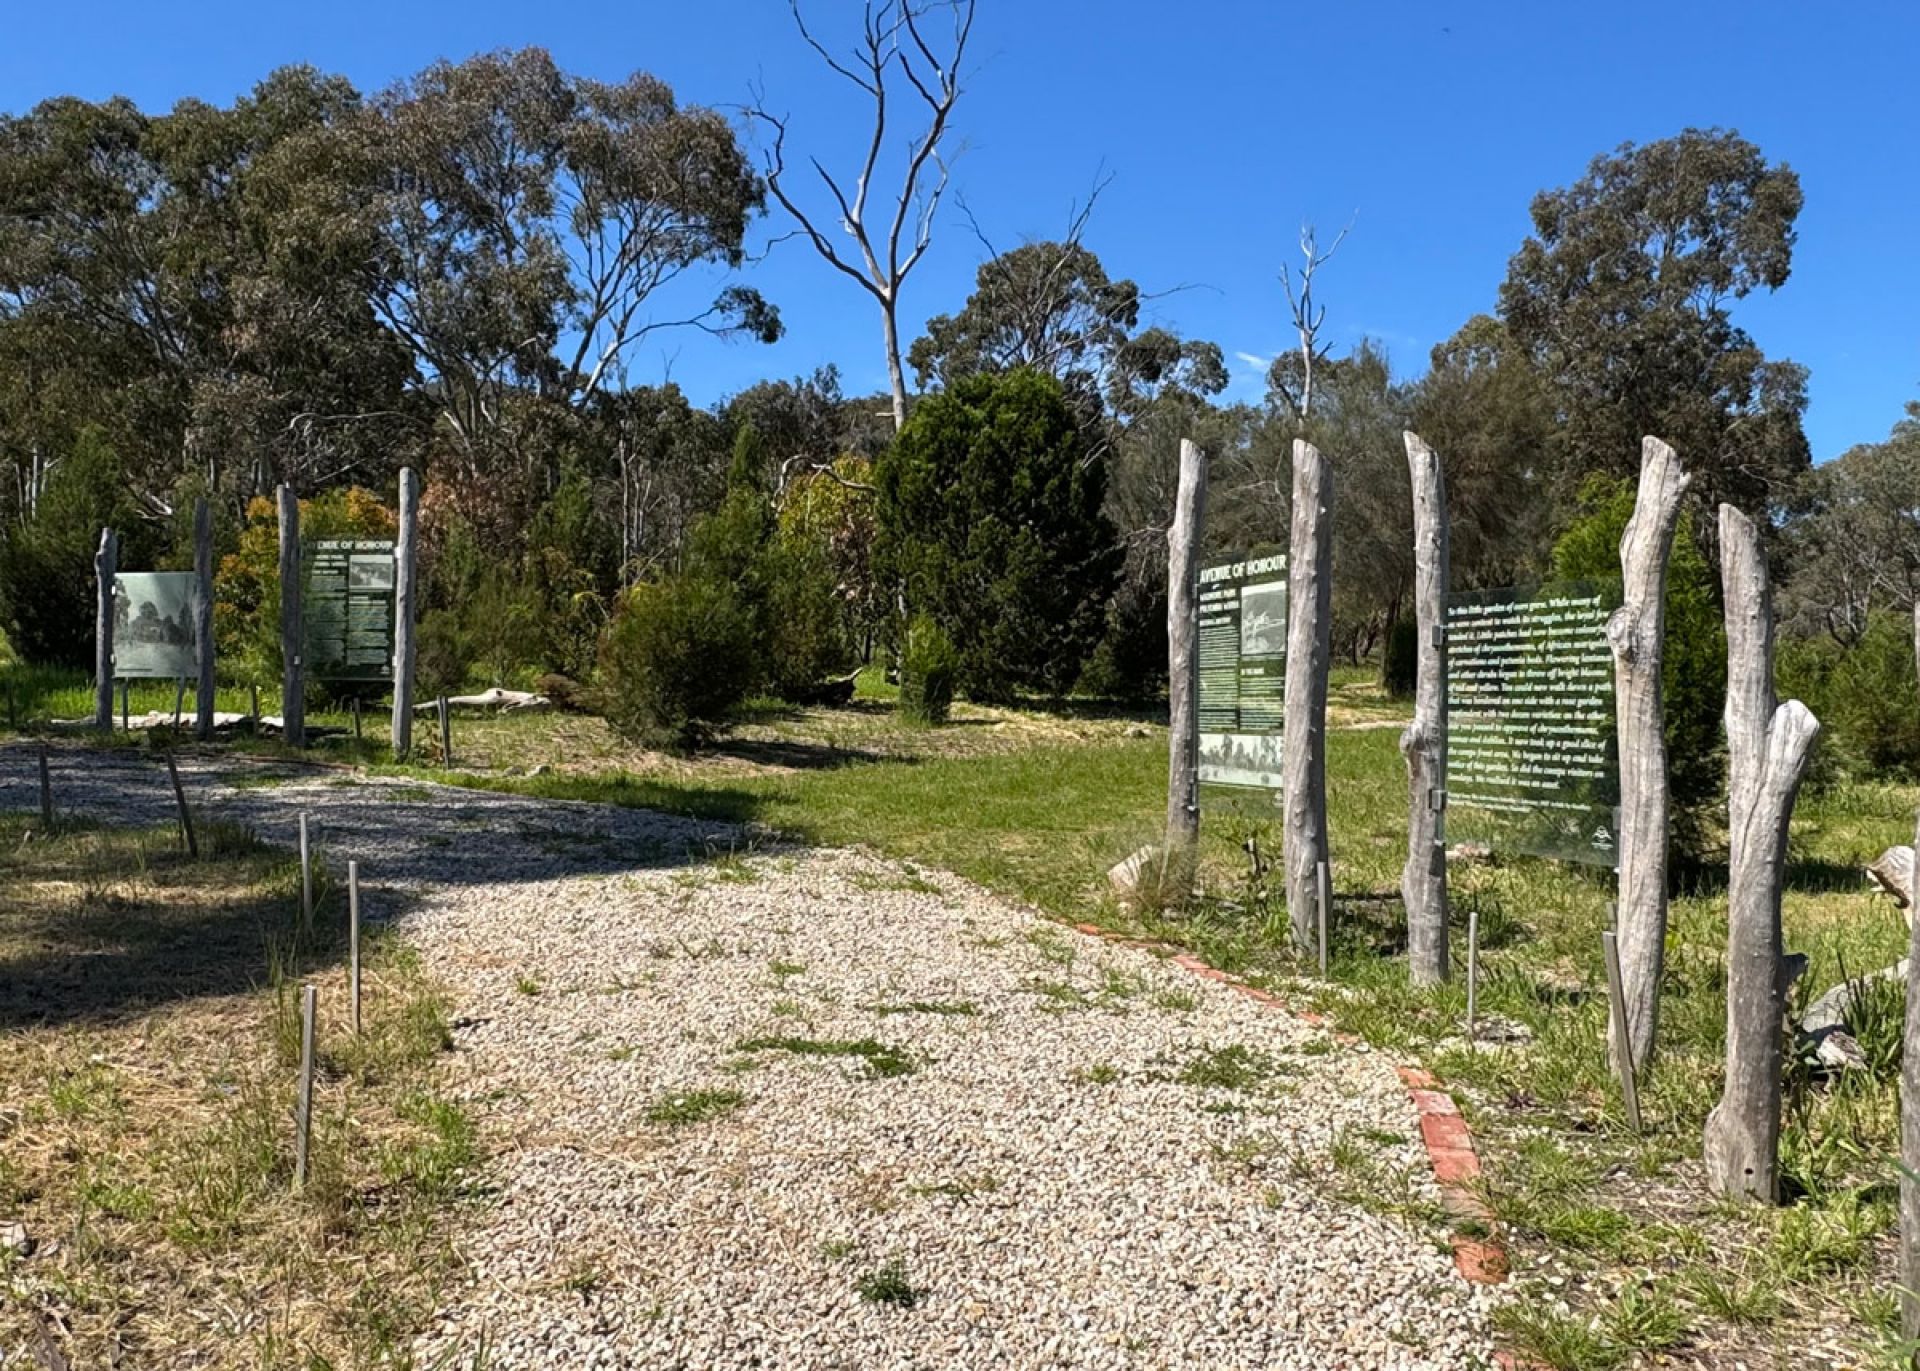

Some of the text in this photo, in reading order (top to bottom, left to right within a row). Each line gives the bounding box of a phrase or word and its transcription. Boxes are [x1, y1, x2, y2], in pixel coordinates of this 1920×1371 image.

[340, 541, 353, 549] OF
[1200, 555, 1286, 584] AVENUE OF HONOUR
[1592, 594, 1602, 606] of
